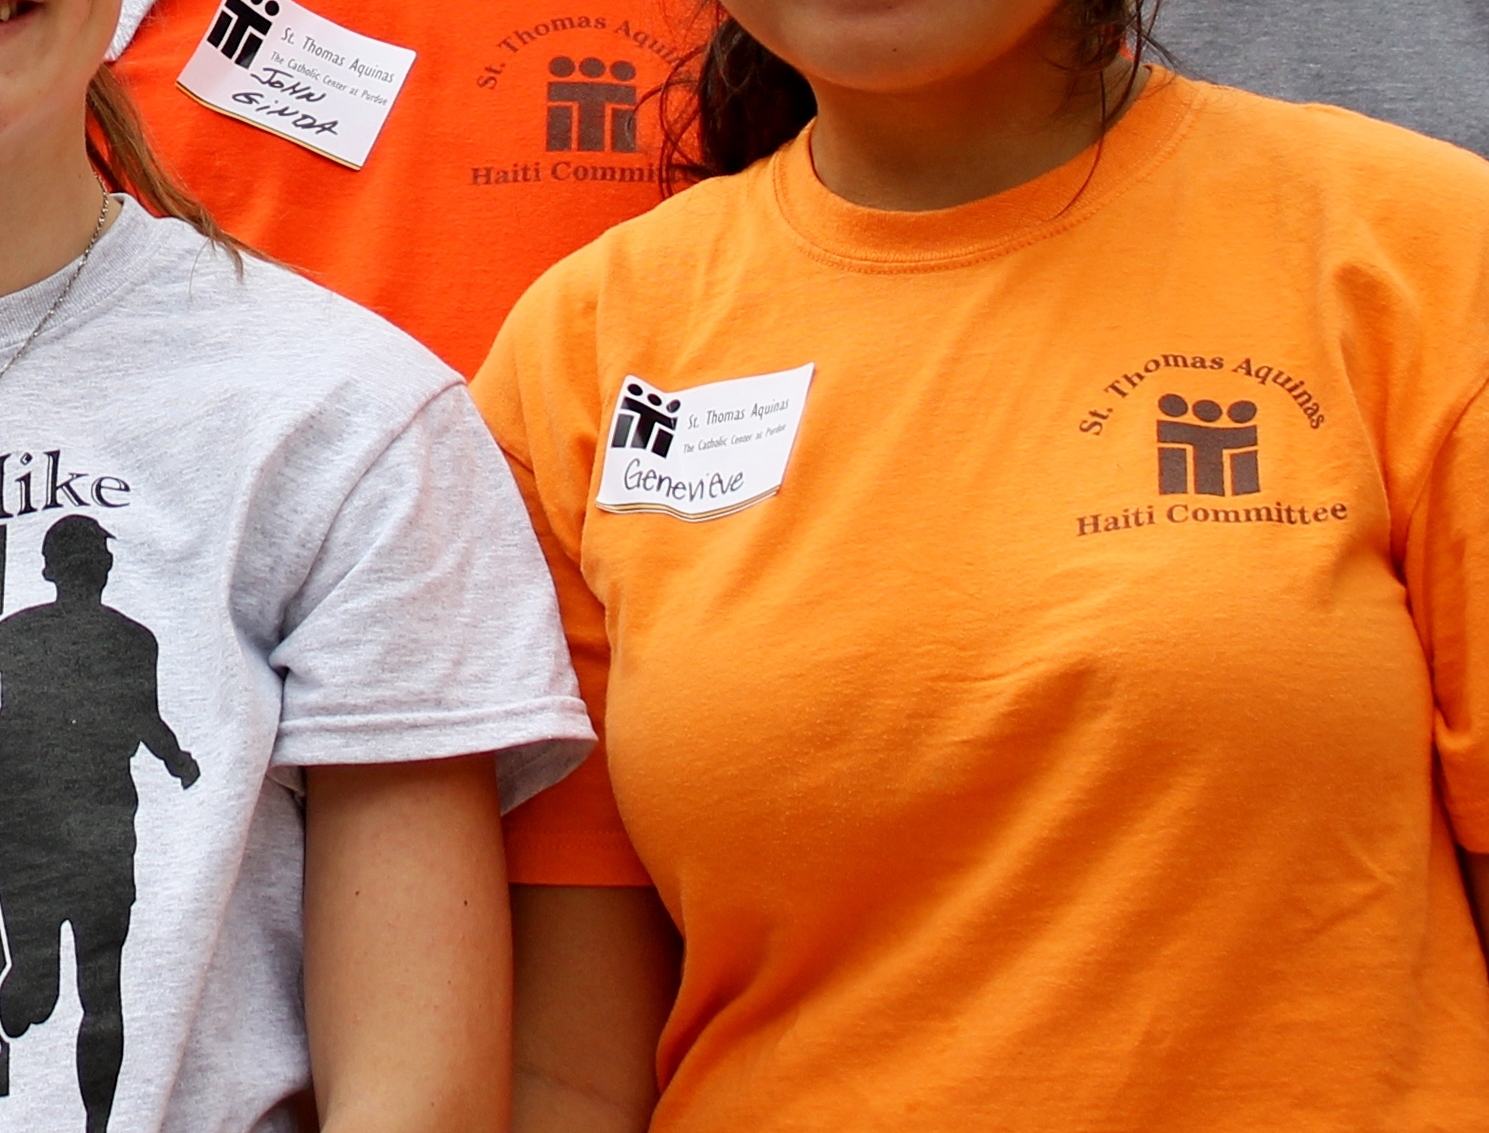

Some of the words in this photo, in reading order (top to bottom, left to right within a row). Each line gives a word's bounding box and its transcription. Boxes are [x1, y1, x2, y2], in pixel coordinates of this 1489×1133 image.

[281, 27, 295, 45] St.
[302, 36, 346, 67] Thomas
[349, 58, 396, 83] Aquinas
[476, 62, 506, 91] St.
[497, 15, 607, 55] Thomas
[270, 51, 284, 65] The
[287, 58, 320, 80] Catholic
[323, 75, 347, 91] Center
[349, 85, 358, 95] at
[361, 90, 388, 106] Purdue
[471, 162, 541, 186] Haiti
[687, 413, 699, 430] St.
[706, 409, 745, 426] Thomas
[750, 398, 790, 421] Aquinas
[1078, 403, 1113, 436] St.
[1103, 353, 1224, 400] Thomas
[1232, 357, 1325, 430] Aquinas
[683, 443, 695, 454] The
[698, 435, 727, 451] Catholic
[731, 433, 753, 445] Center
[765, 423, 787, 437] Purdue
[624, 458, 744, 502] Genevieve
[1076, 505, 1156, 537] Haiti
[1166, 501, 1348, 526] Committee
